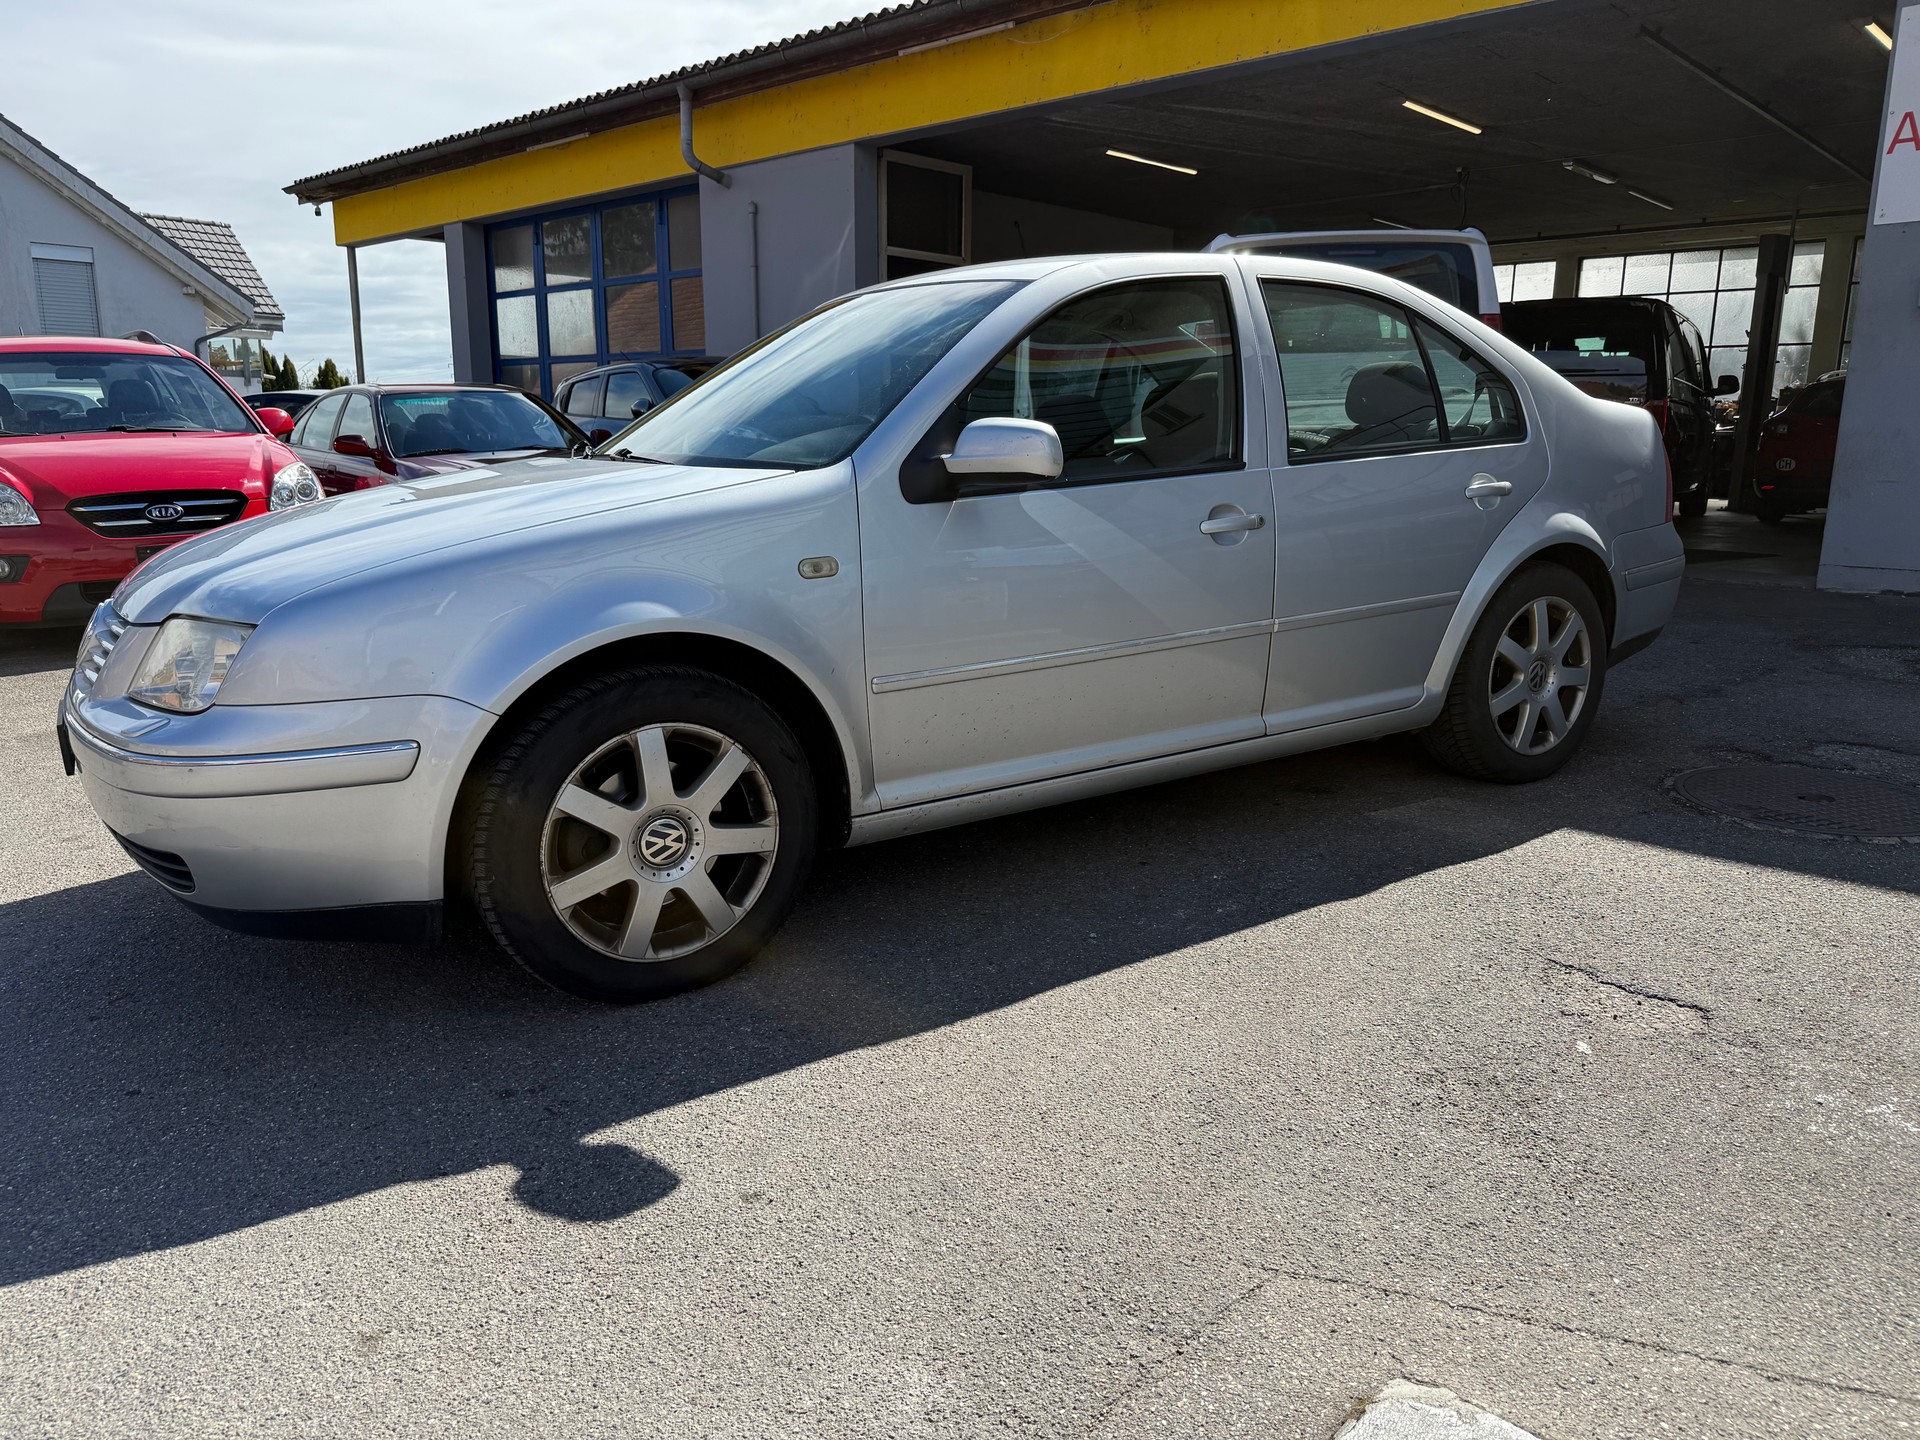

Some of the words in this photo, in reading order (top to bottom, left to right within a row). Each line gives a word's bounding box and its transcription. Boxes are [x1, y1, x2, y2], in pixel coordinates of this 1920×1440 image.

[1778, 459, 1792, 470] CH
[151, 507, 177, 517] KIA
[640, 818, 687, 865] VW
